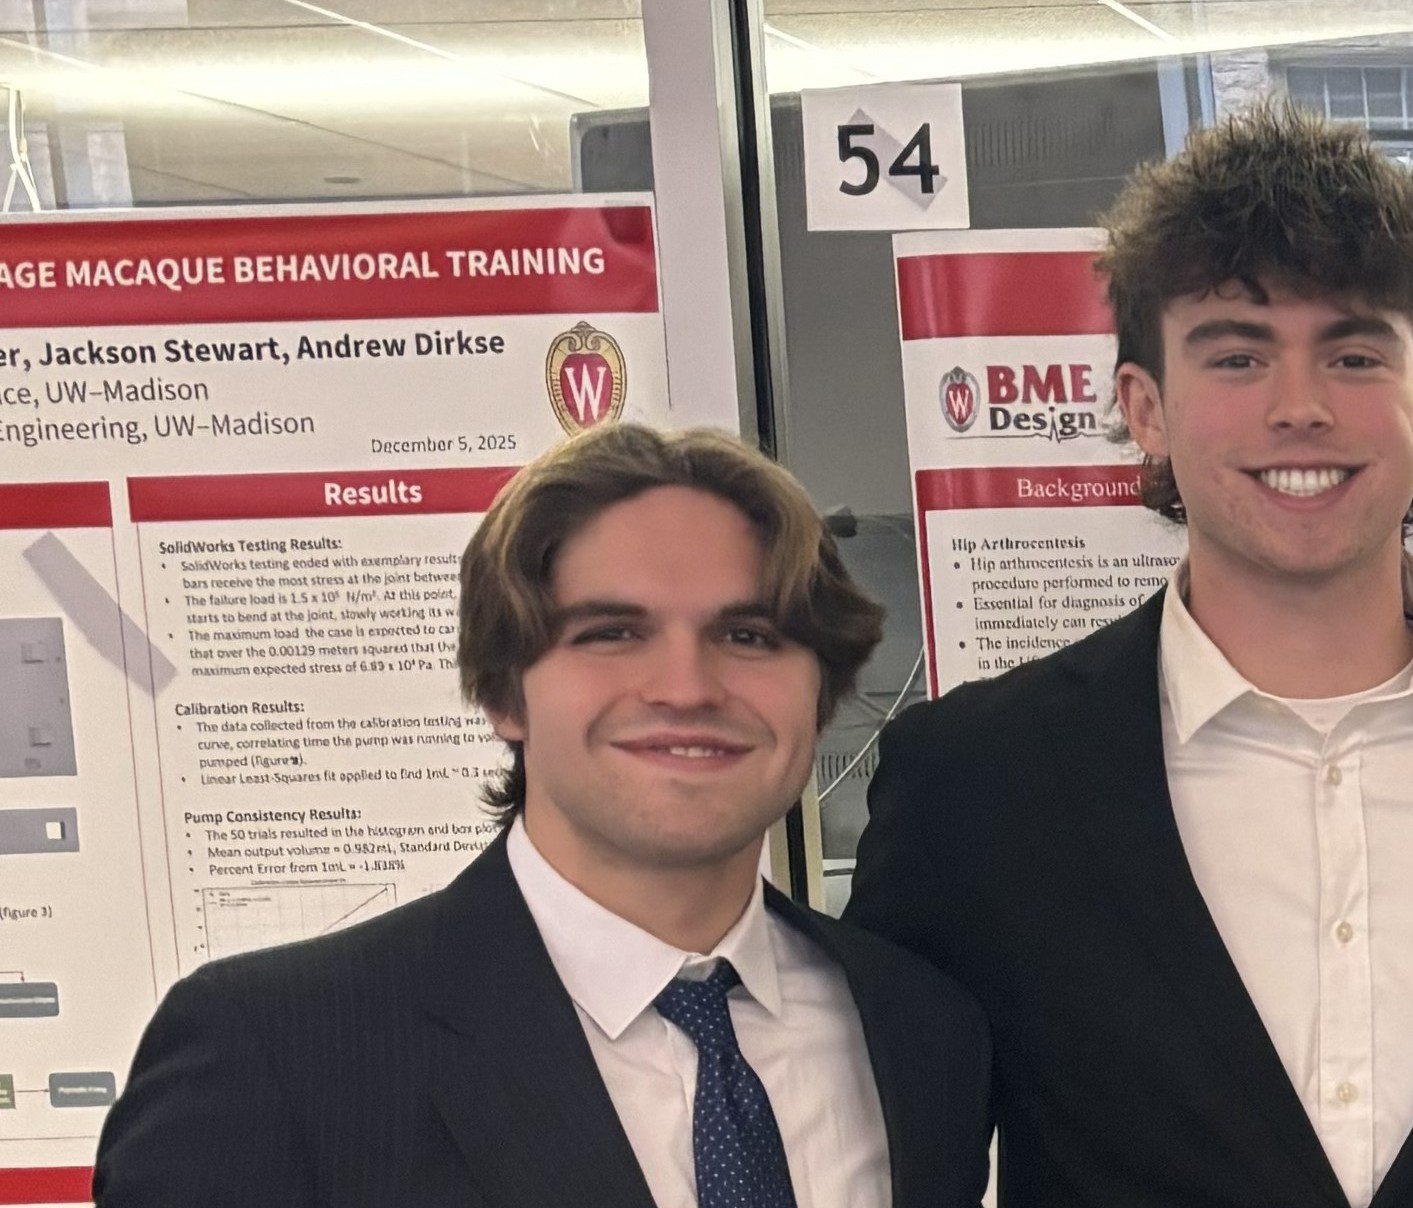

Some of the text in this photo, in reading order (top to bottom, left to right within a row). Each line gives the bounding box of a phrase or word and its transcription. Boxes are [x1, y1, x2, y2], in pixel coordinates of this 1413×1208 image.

[838, 123, 939, 196] 54
[66, 257, 225, 291] MACAQUE
[234, 251, 439, 283] BEHAVIORAL
[446, 247, 604, 277] TRAINING
[39, 340, 156, 366] Jackson
[164, 337, 289, 366] Stewart,
[297, 334, 405, 359] Andrew
[415, 330, 504, 356] Dirkse
[564, 365, 605, 406] W
[986, 364, 1098, 404] BME
[949, 389, 969, 412] W
[989, 405, 1097, 437] Design
[458, 436, 472, 453] 5,
[478, 434, 516, 450] 2025
[325, 479, 422, 505] Results
[1017, 475, 1142, 502] Background
[159, 536, 342, 555] SolidWorks Testing Results:
[952, 535, 1085, 554] Hip Arthrocentesis
[175, 698, 304, 716] Calibration Results:
[185, 804, 361, 828] Pump Consistency Results:
